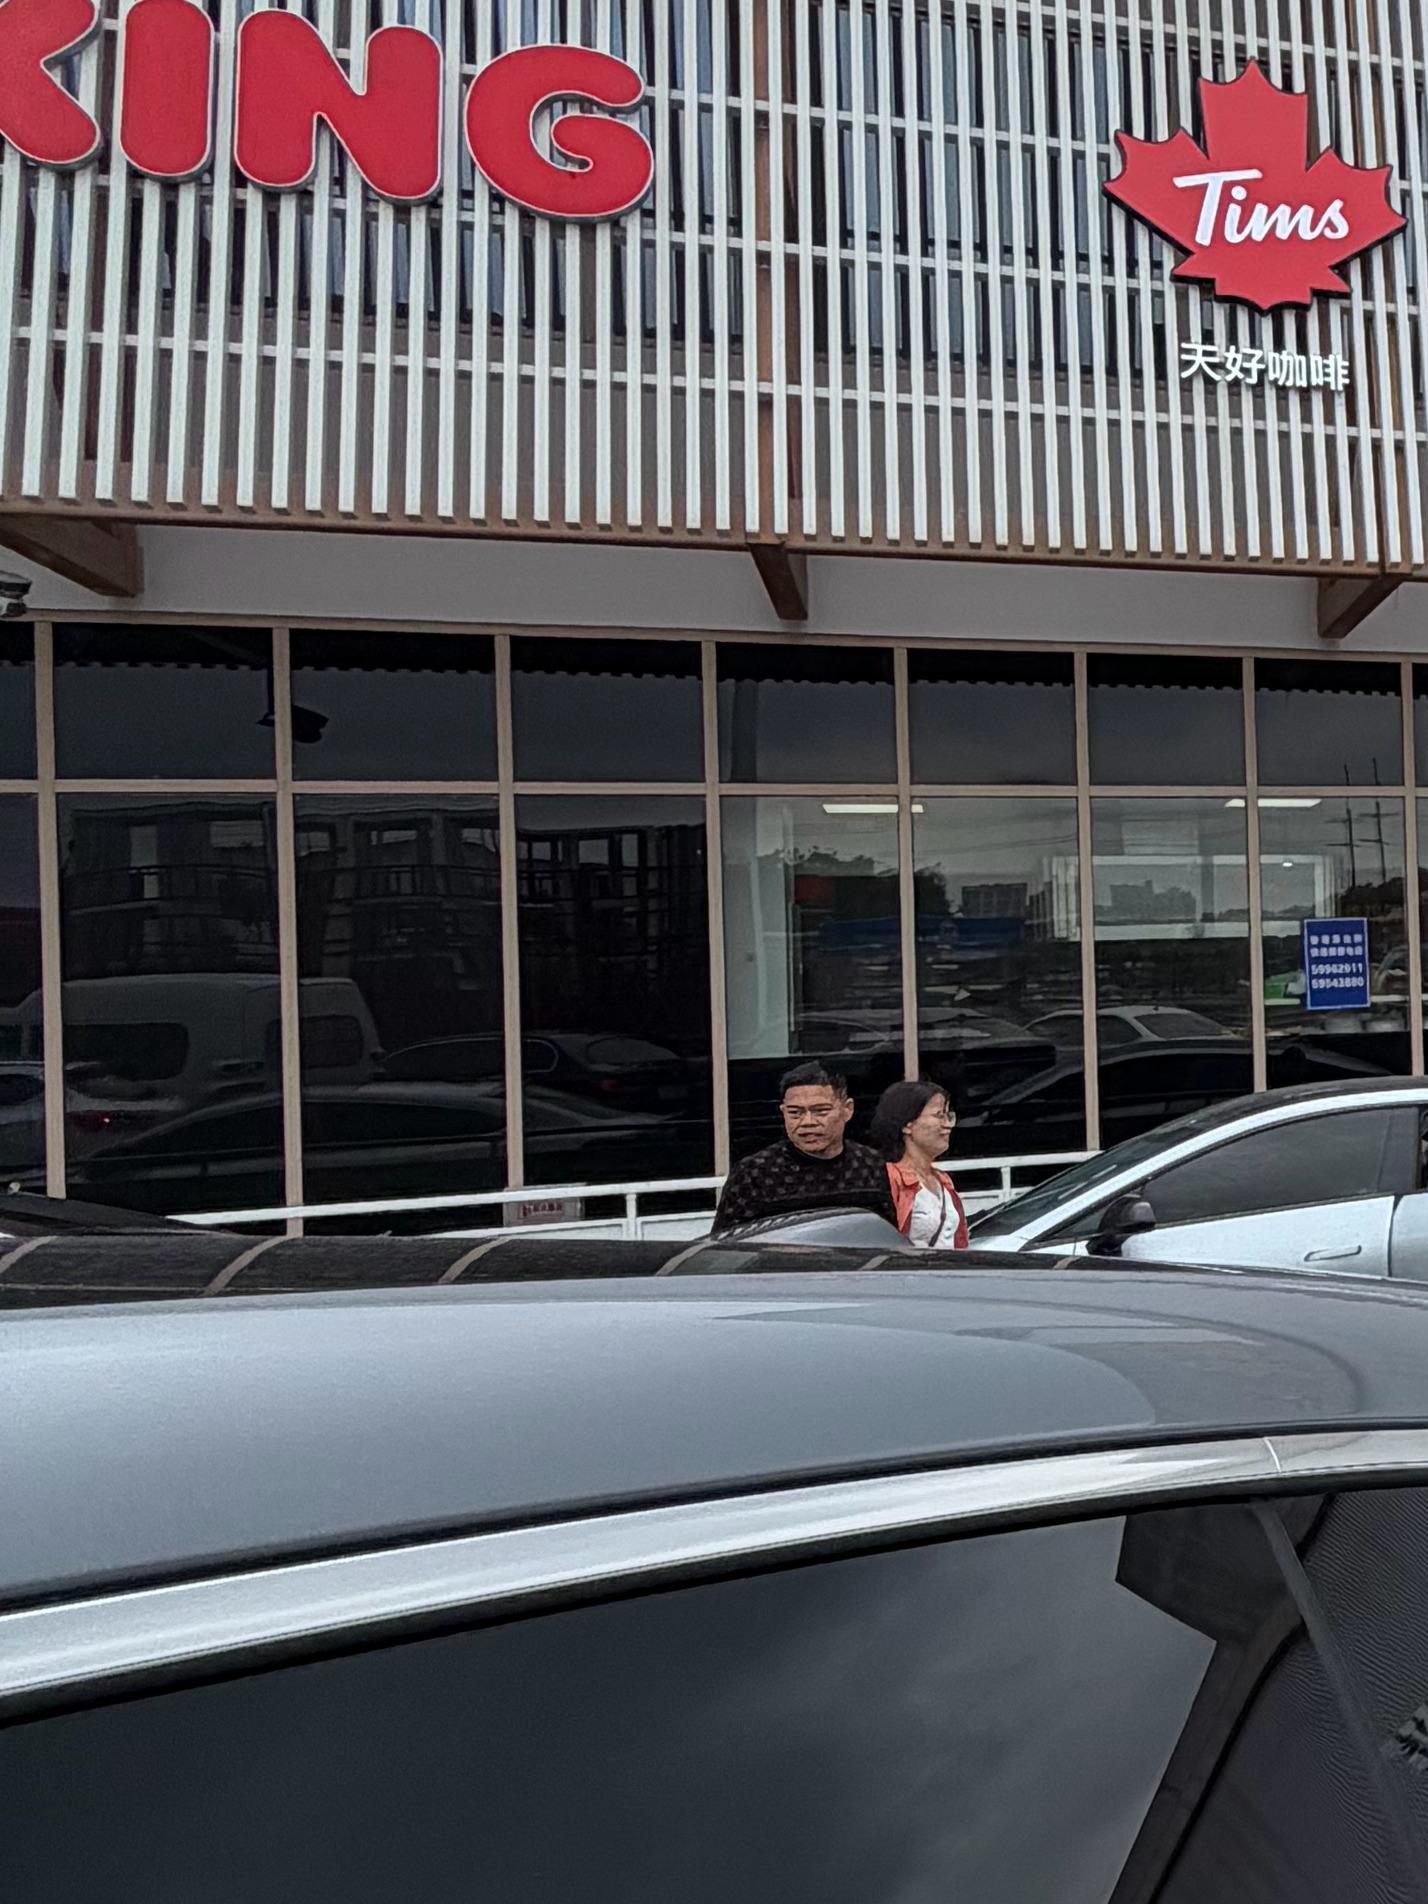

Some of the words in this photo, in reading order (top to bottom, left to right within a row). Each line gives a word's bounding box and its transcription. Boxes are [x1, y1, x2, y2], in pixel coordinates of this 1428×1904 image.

[1173, 169, 1350, 246] Tims
[1180, 342, 1350, 392] 天好咖啡
